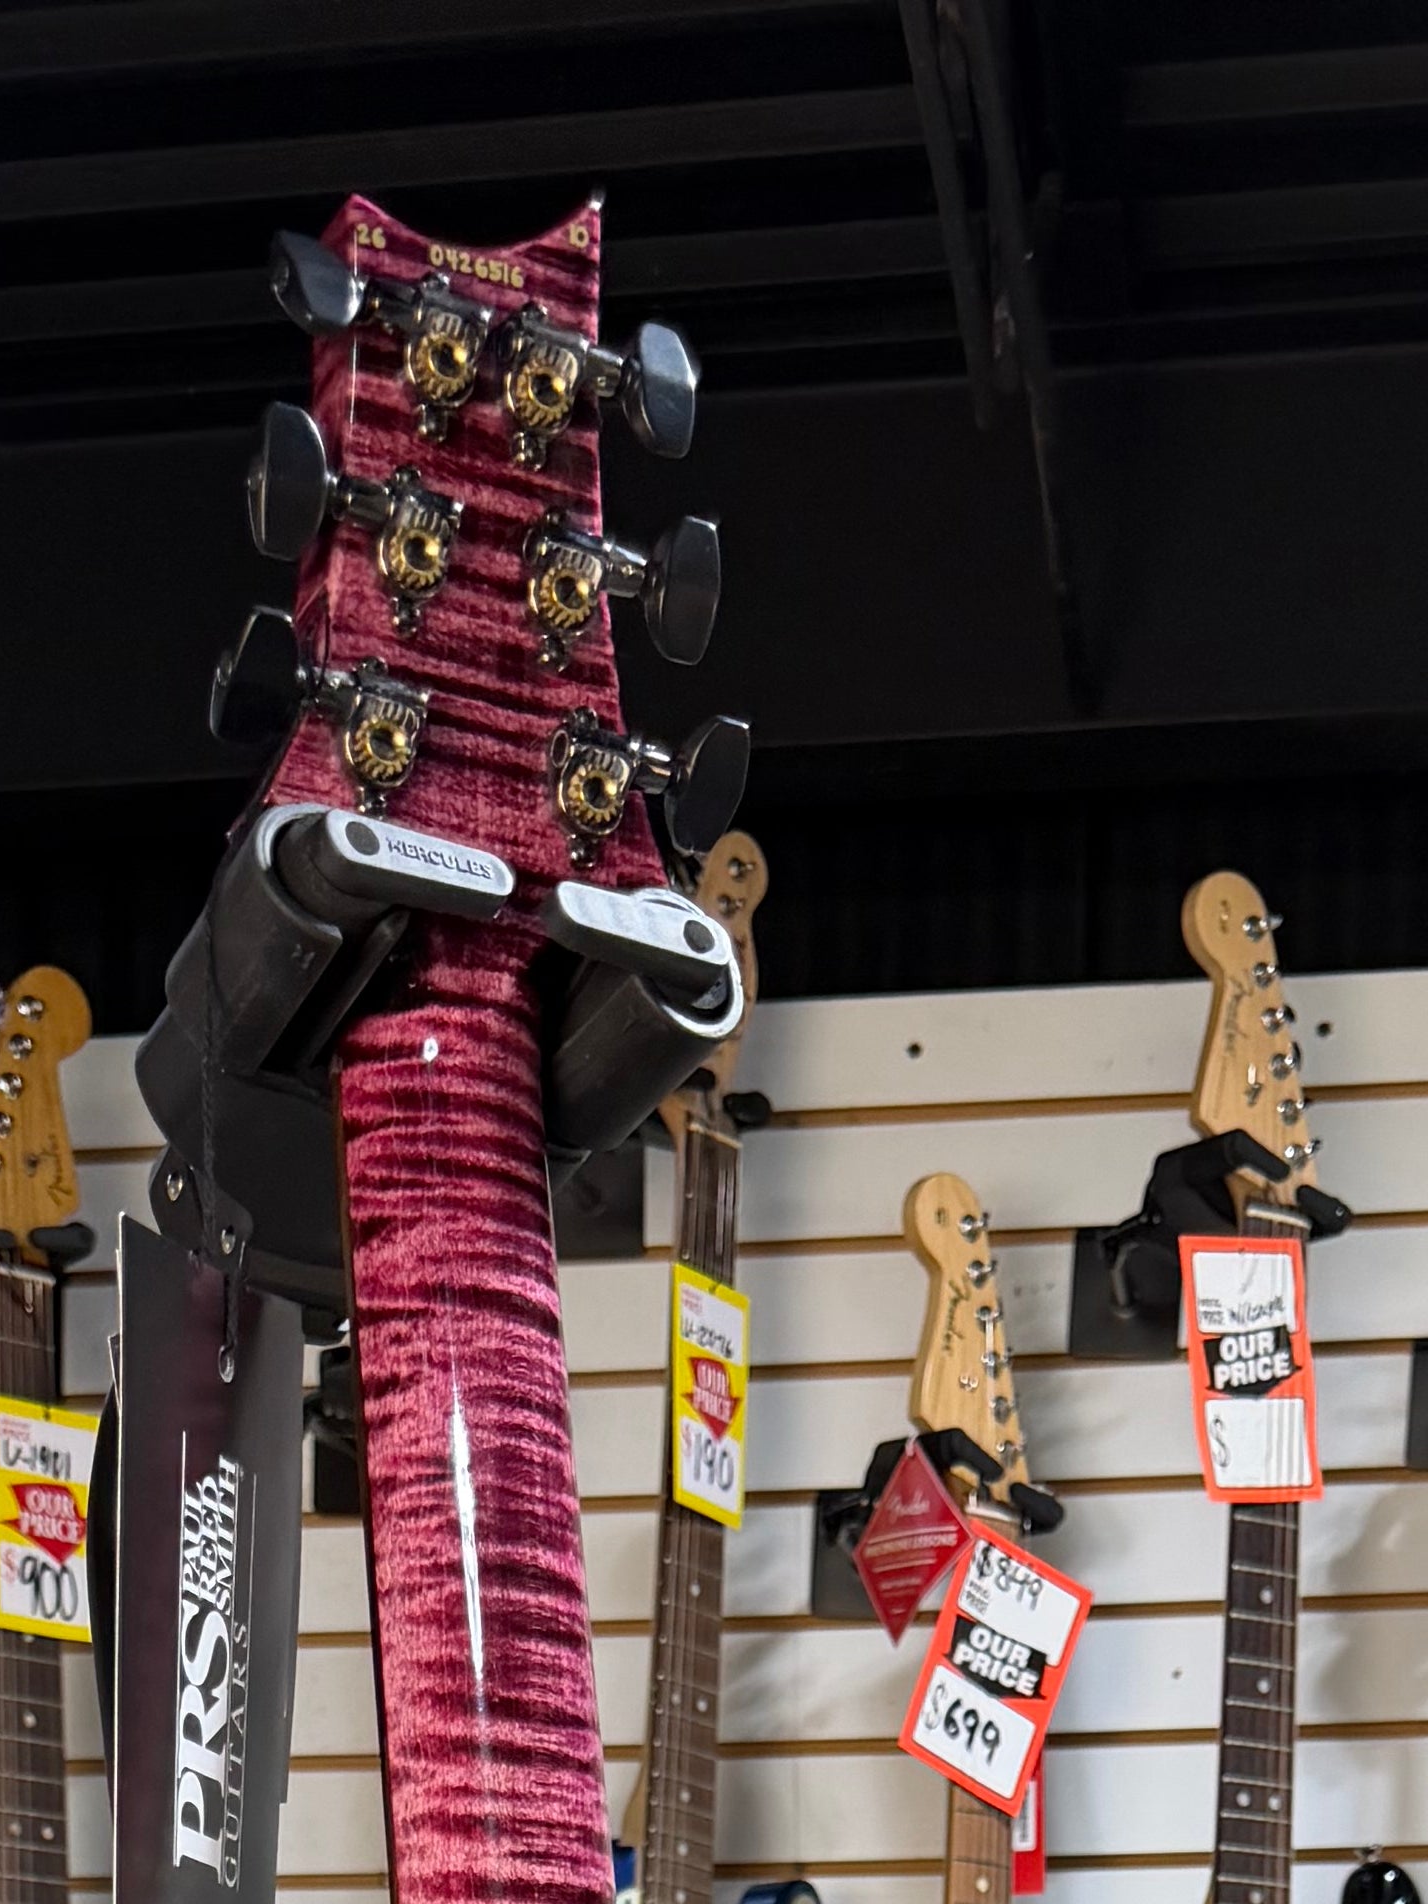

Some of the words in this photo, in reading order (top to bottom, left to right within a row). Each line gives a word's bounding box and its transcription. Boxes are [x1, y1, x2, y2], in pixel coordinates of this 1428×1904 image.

[356, 223, 386, 250] 26
[428, 244, 525, 289] 0426516
[384, 836, 493, 880] HERCULES
[1218, 1330, 1276, 1362] OUR
[697, 1359, 729, 1398] OUR
[1213, 1352, 1292, 1391] PRICE
[693, 1384, 733, 1424] PRICE
[25, 1488, 75, 1518] OUR
[20, 1512, 81, 1544] PRICE
[183, 1481, 203, 1600] PAUL
[198, 1475, 220, 1607] REED
[214, 1454, 237, 1616] SMITH
[952, 1640, 1040, 1698] PRICE
[969, 1622, 1033, 1671] OUR
[174, 1598, 231, 1885] PRS
[923, 1681, 1002, 1767] $699
[224, 1621, 248, 1888] GUITARS
